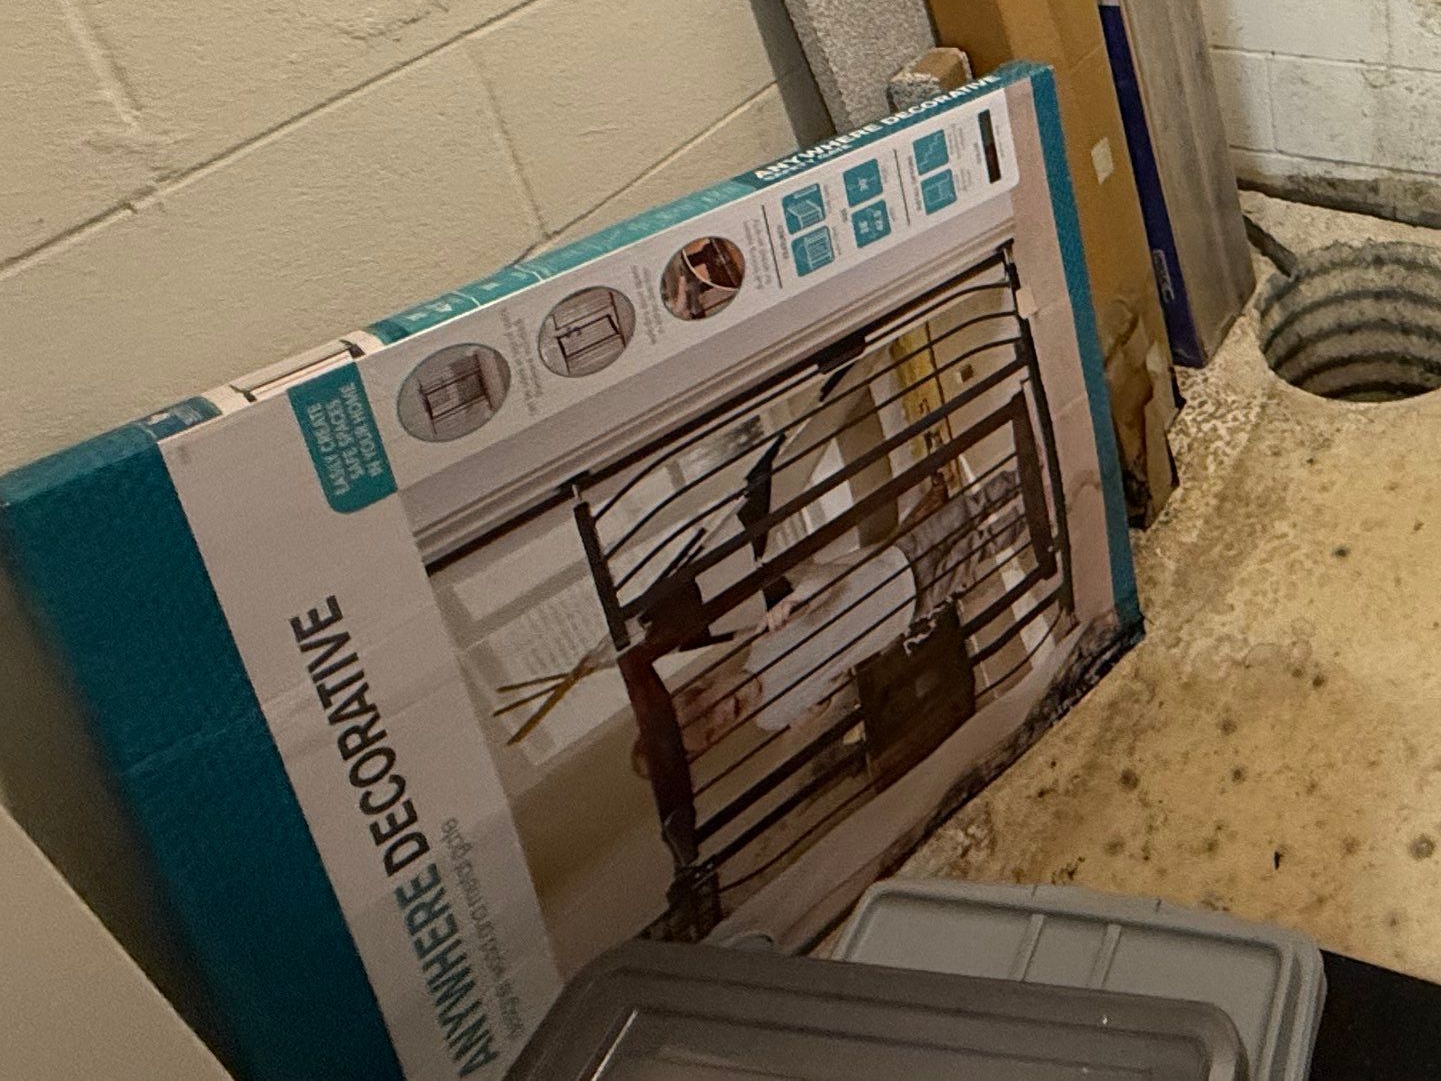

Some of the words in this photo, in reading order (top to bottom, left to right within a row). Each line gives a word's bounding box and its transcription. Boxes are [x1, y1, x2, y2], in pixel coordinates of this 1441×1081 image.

[754, 122, 883, 179] ANYWHERE
[881, 75, 1001, 125] DECORATIVE
[339, 382, 366, 424] HOME
[289, 595, 430, 878] DECORATIVE
[441, 817, 474, 859] gate
[394, 863, 499, 1078] ANYWHERE
